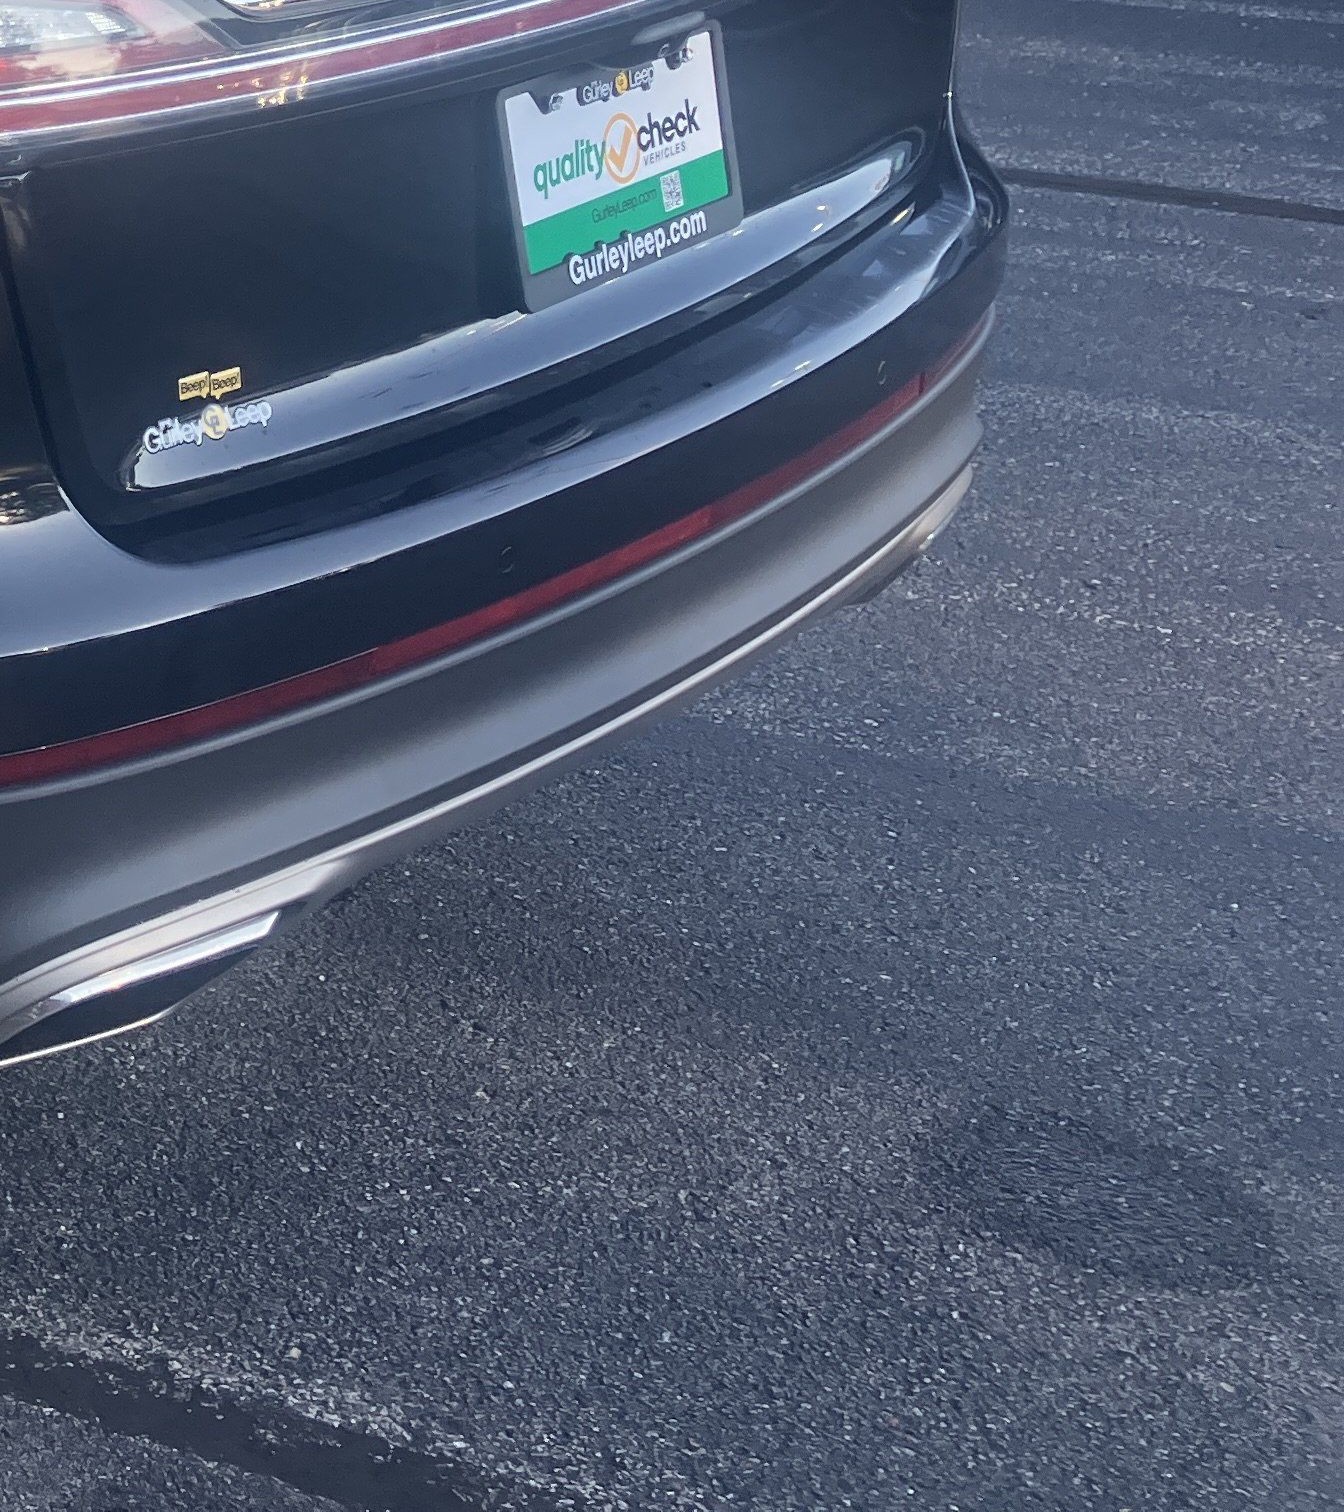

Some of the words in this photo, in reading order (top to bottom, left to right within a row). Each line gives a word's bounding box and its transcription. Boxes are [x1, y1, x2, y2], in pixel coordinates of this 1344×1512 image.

[533, 138, 607, 199] quality
[637, 98, 700, 152] check
[643, 141, 687, 167] VEHICLES
[568, 210, 708, 286] Gurleyleep.com
[180, 374, 209, 394] Beep!
[212, 371, 240, 391] Beep!
[224, 400, 273, 431] Leep
